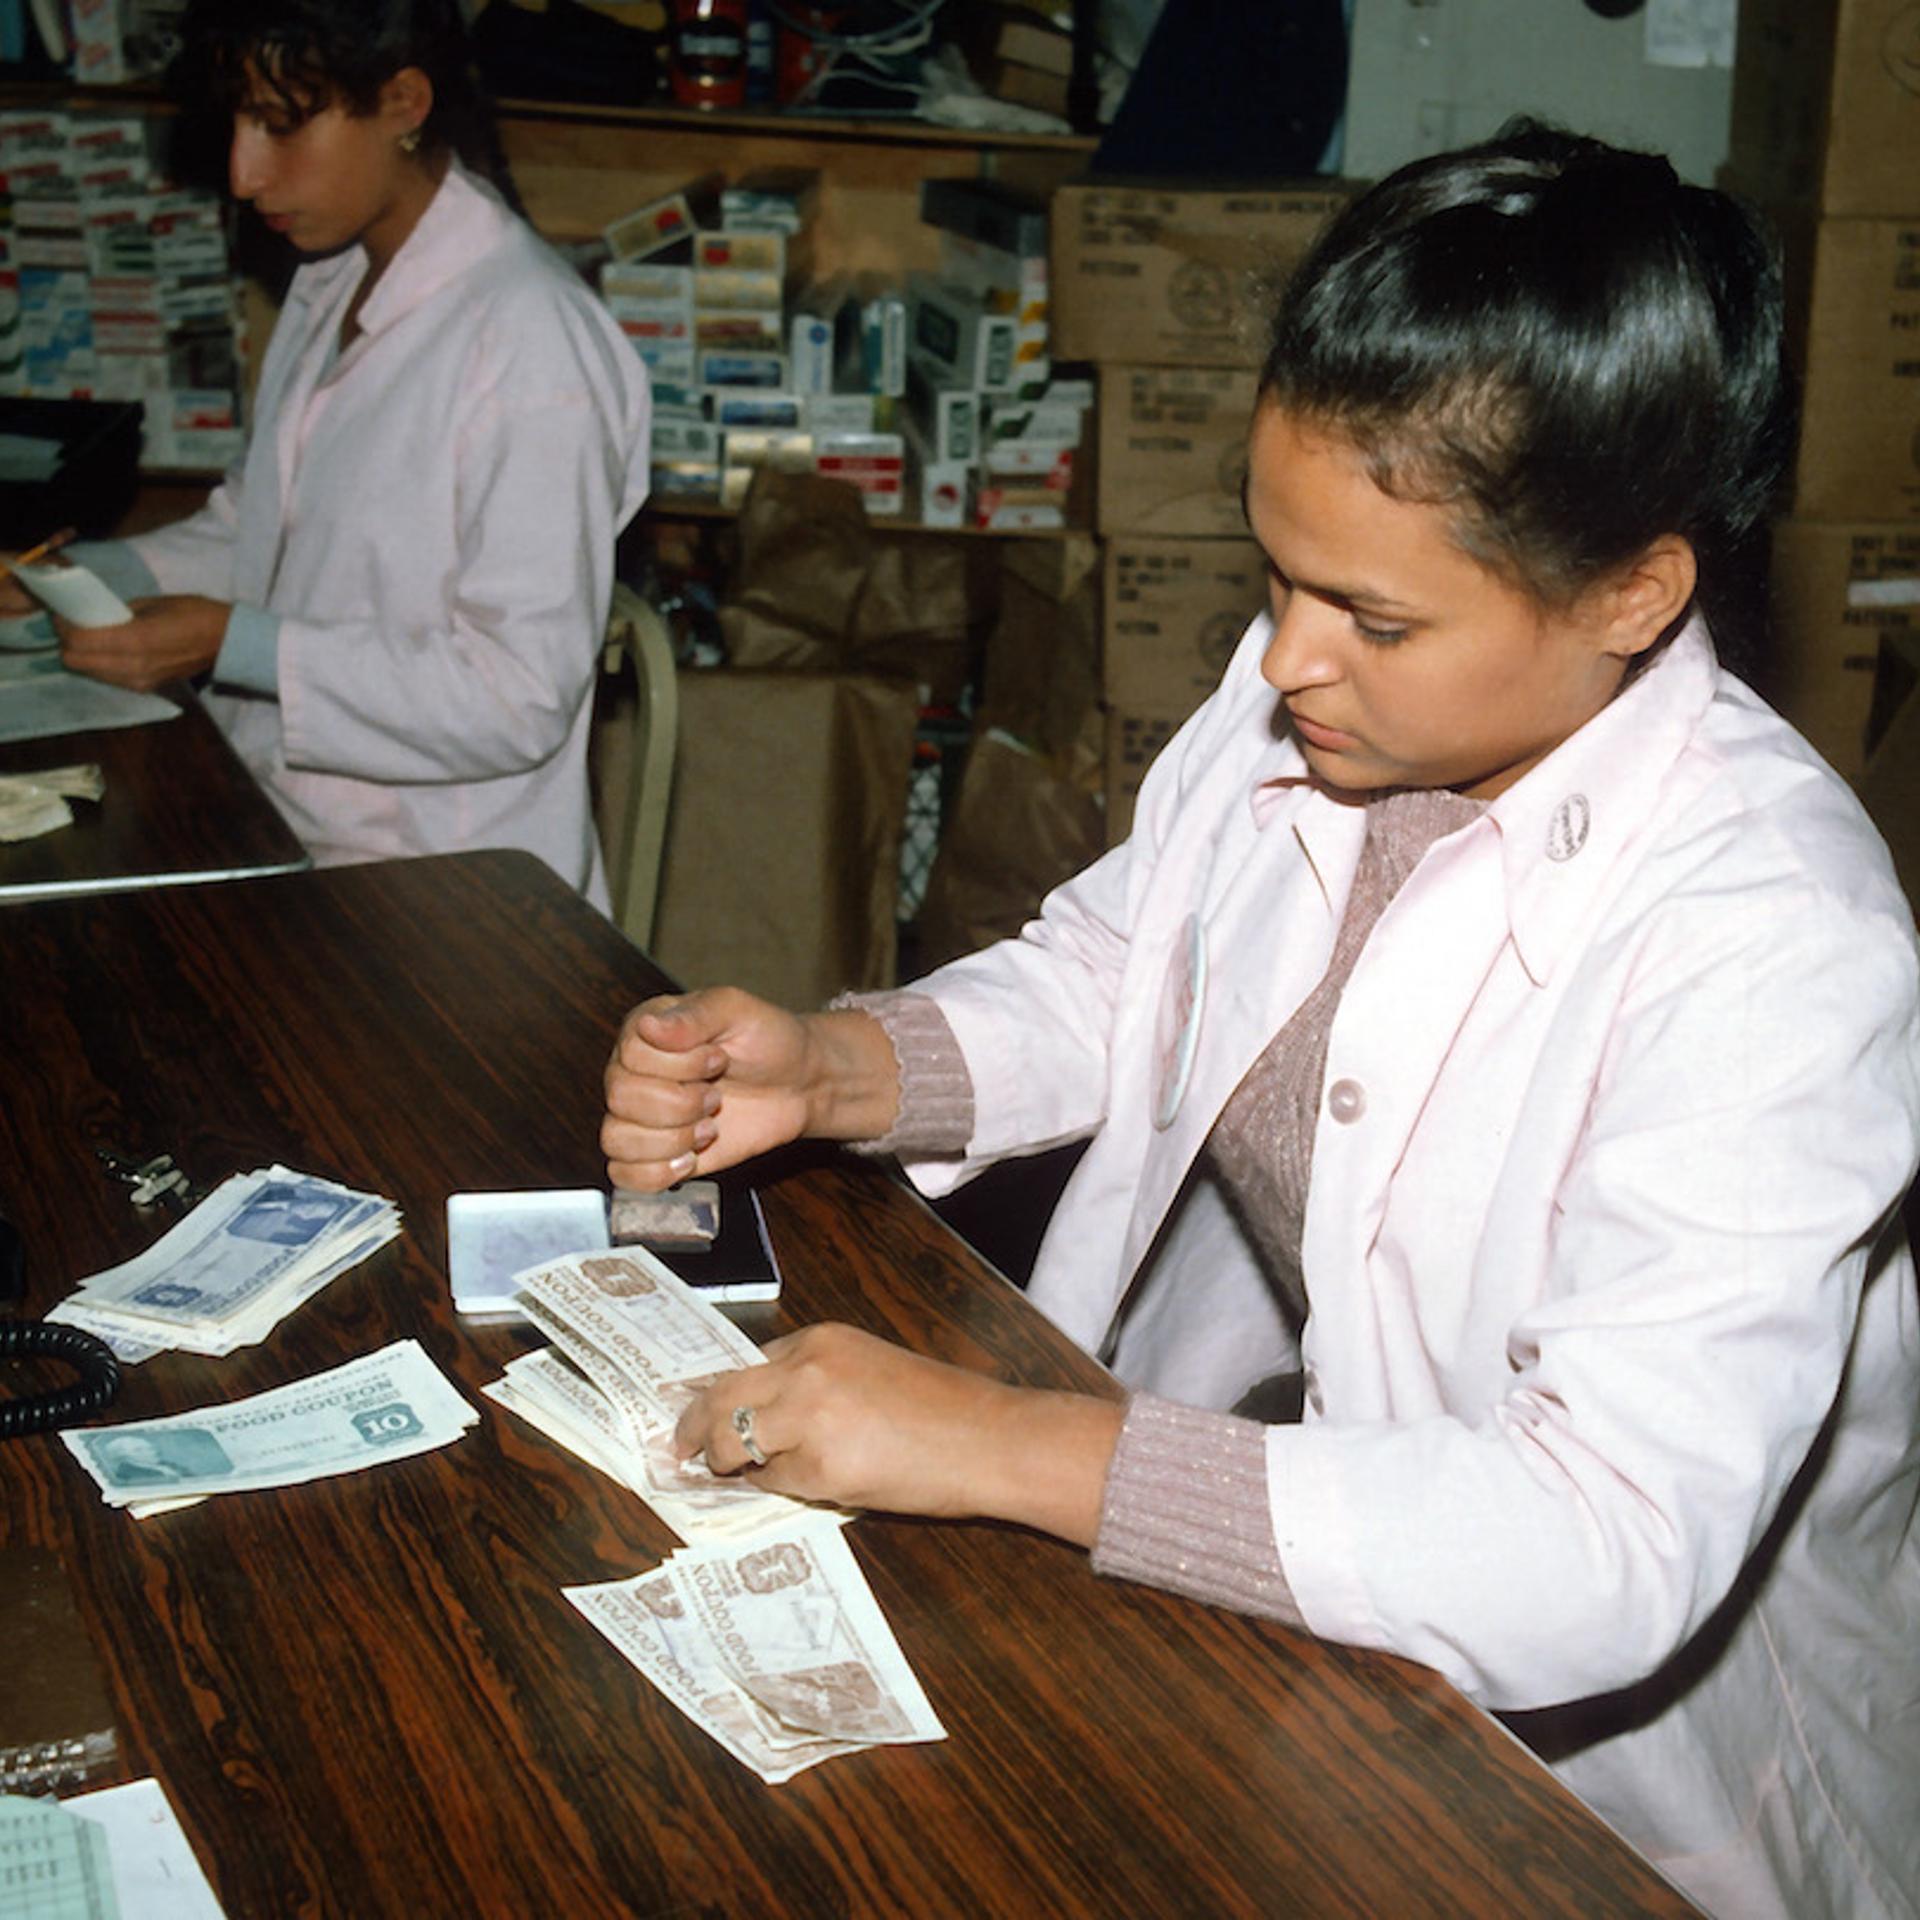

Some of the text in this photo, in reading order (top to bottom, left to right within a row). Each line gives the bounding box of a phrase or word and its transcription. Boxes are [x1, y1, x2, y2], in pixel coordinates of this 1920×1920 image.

[541, 1272, 616, 1334] COUPON
[613, 1334, 663, 1382] FOOD
[215, 1410, 286, 1434] FOOD
[291, 1378, 394, 1416] COUPON
[363, 1412, 410, 1437] 10
[593, 1592, 659, 1655] COUPON
[693, 1563, 736, 1632] COUPON
[655, 1653, 707, 1696] FOOD
[725, 1632, 761, 1673] FOOD
